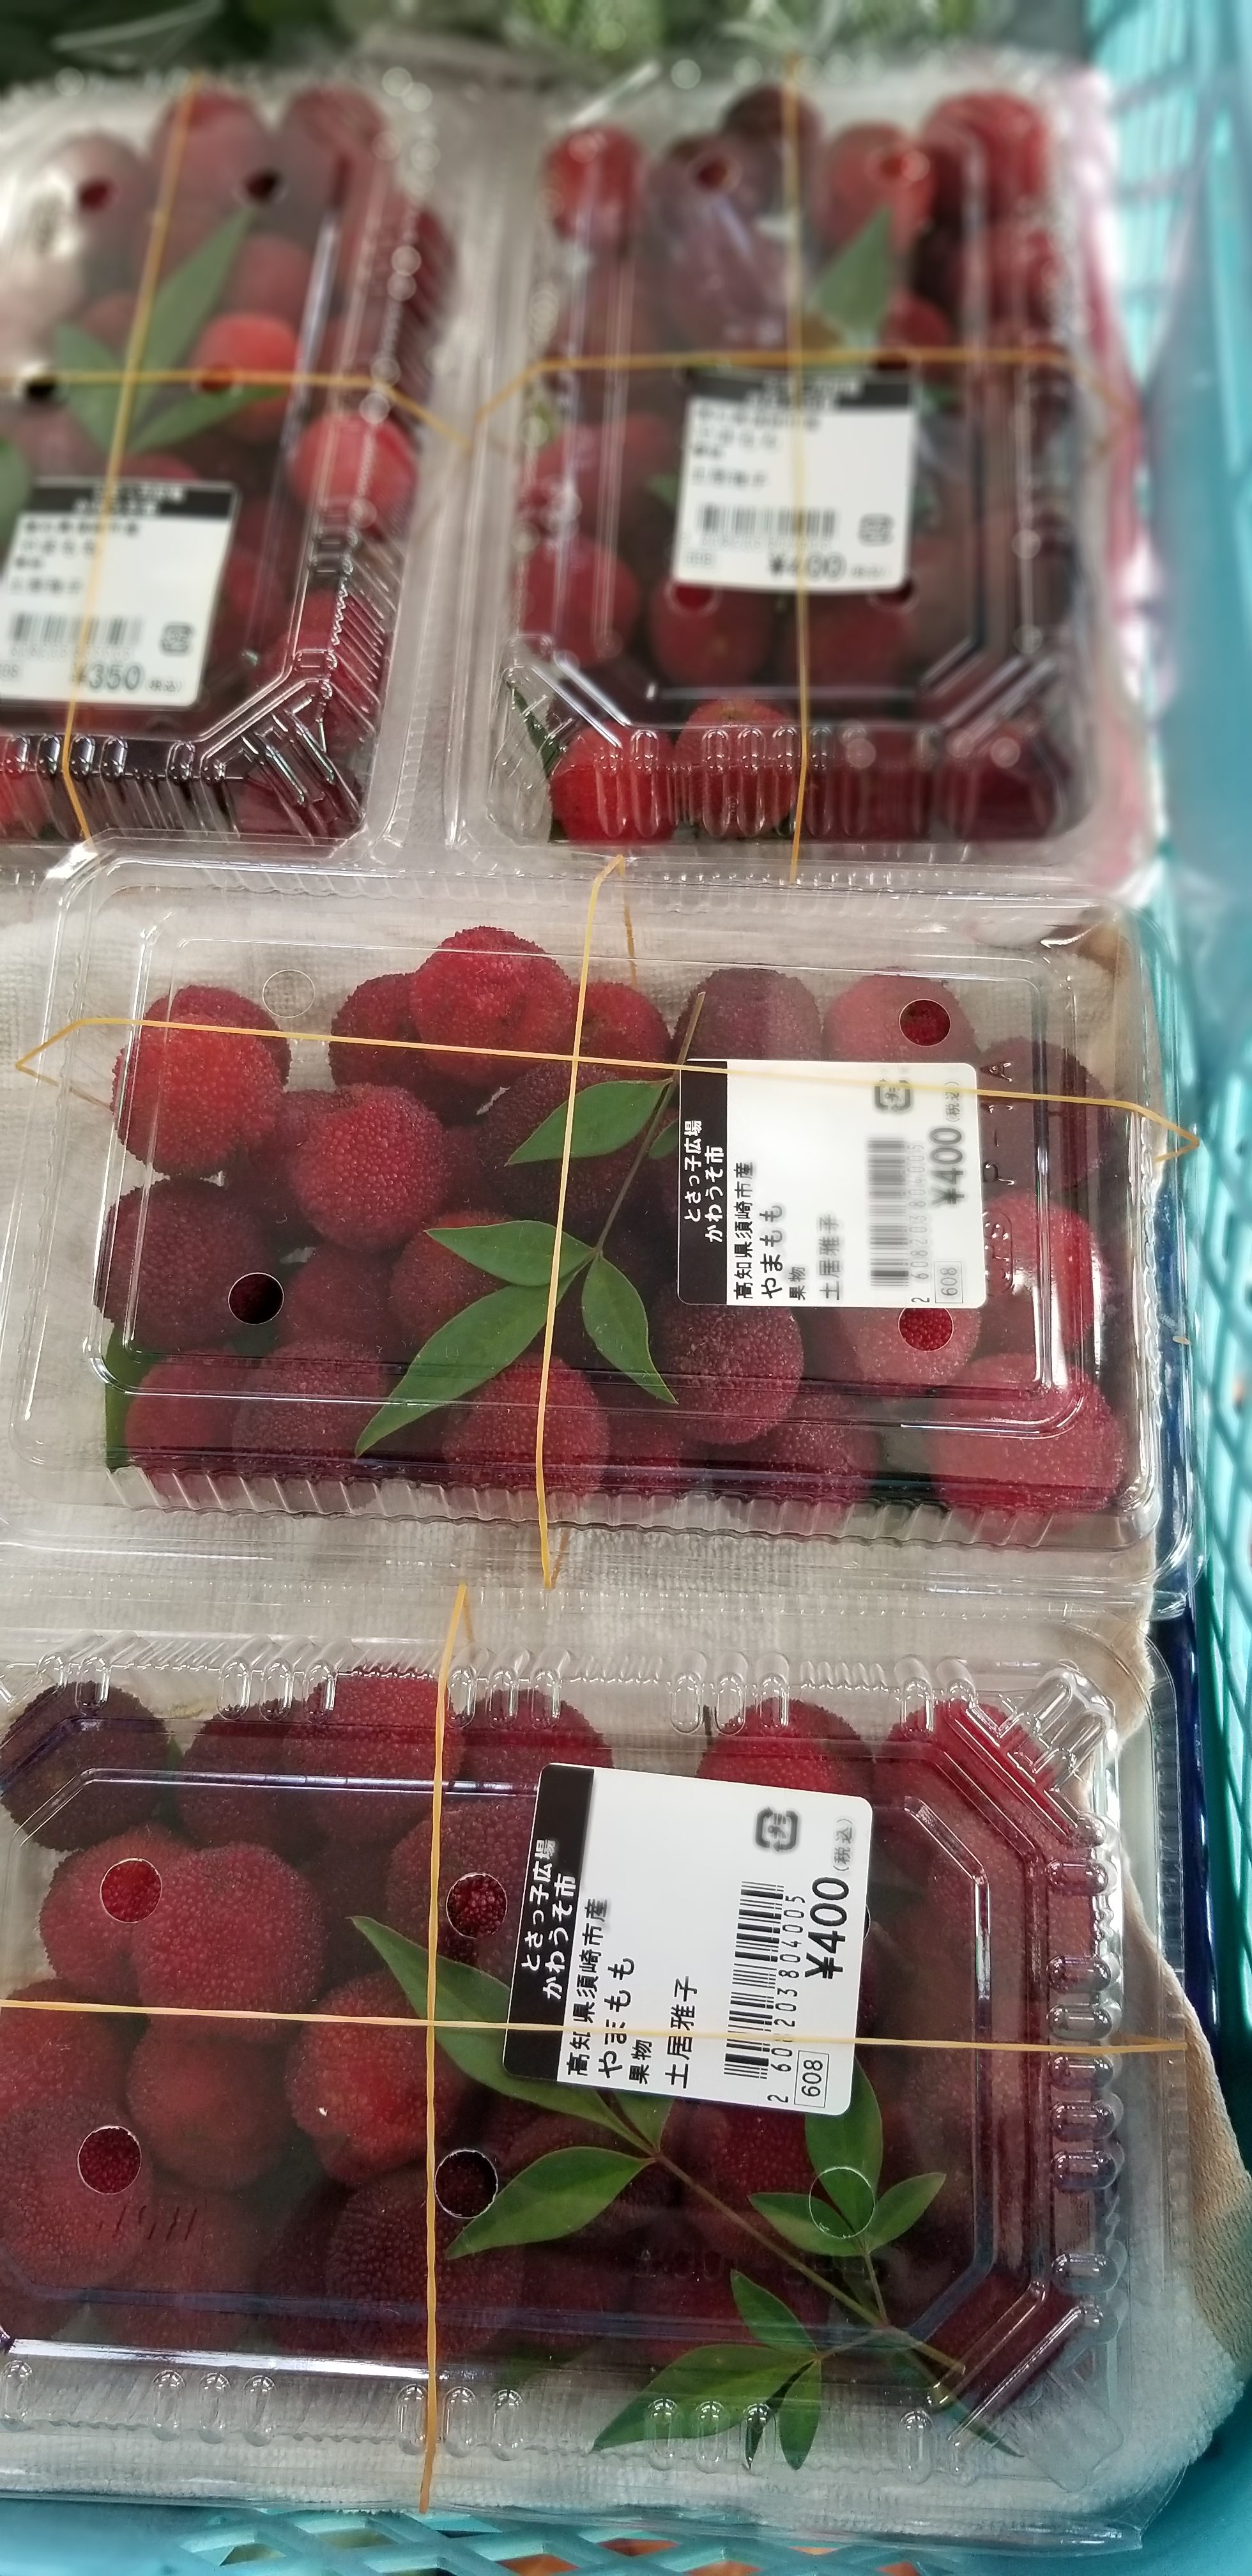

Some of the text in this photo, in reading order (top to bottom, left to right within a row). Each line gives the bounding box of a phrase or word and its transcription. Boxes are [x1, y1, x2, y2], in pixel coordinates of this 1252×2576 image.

[72, 663, 141, 691] ¥350
[684, 1120, 702, 1222] とさっ子広場
[705, 1146, 724, 1242] かわうそ市
[929, 1126, 965, 1206] ¥400
[733, 1162, 754, 1300] 高知県須崎市産
[760, 1205, 783, 1299] やまもも
[819, 1215, 841, 1300] 土居雅子
[789, 1266, 805, 1301] 果物
[940, 1267, 958, 1296] 608
[521, 1839, 556, 1972] とさっ子広場
[542, 1873, 577, 2000] かわうそ市
[805, 1876, 850, 1980] ¥400
[566, 1897, 611, 2076] 高知県須崎市産
[598, 1957, 635, 2079] やまもも
[664, 1975, 698, 2089] 土居雅子
[770, 1894, 806, 2072] 60203804005
[629, 2039, 652, 2084] 果物
[801, 2059, 823, 2097] 608
